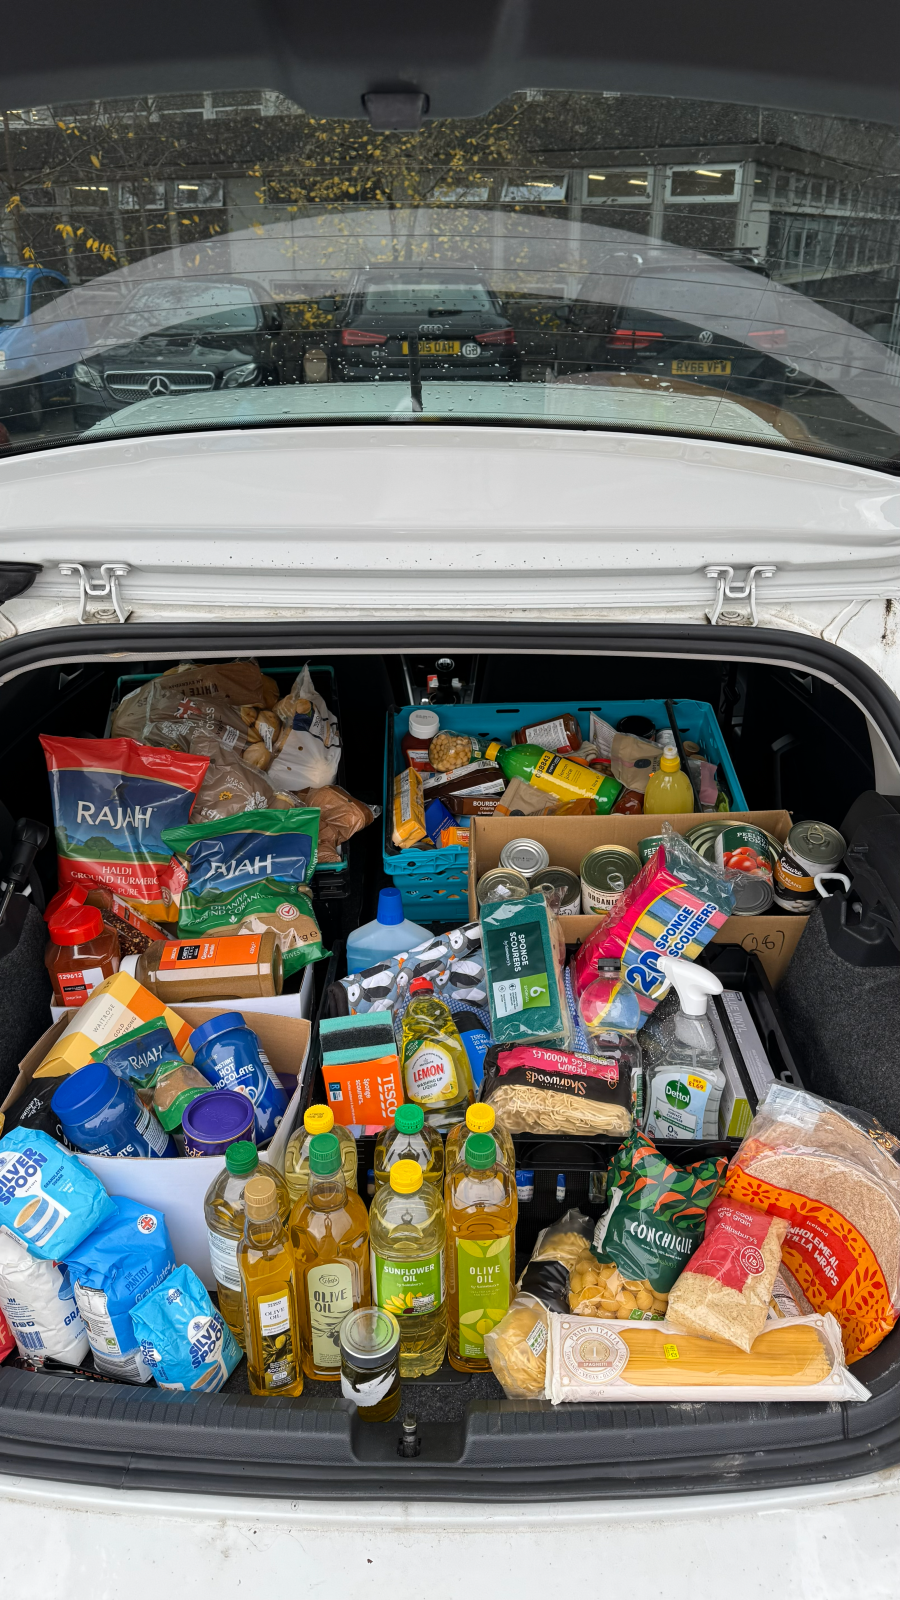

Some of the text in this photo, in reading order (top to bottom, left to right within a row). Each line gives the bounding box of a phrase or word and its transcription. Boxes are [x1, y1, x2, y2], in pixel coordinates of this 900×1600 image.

[465, 345, 479, 356] GB
[676, 362, 727, 373] RY66 VFW
[226, 775, 244, 789] M&S
[77, 800, 152, 829] RAJAH
[71, 871, 159, 885] GROUND TURMERIC
[102, 866, 132, 875] HALDI
[118, 887, 139, 896] PURE
[211, 893, 248, 910] DHANIYA
[655, 906, 694, 950] SPONGE
[668, 903, 717, 957] SCOURERS
[509, 931, 521, 972] SCOURERS
[518, 934, 529, 966] SPONGE
[626, 950, 664, 995] 20
[530, 986, 546, 997] 6
[93, 1003, 115, 1033] WAITROSE
[725, 992, 747, 1033] BLUE VINYL
[114, 1023, 125, 1038] GOLD
[128, 1045, 162, 1070] RAJAH
[533, 1050, 587, 1068] EGG NOODLES
[214, 1064, 255, 1090] HOCOLATE
[219, 1063, 236, 1077] HOT
[413, 1063, 444, 1083] LEMON
[558, 1063, 587, 1075] MEDIUM
[363, 1078, 371, 1099] Sponge
[417, 1078, 436, 1088] WASHING
[526, 1070, 587, 1095] Sharwood's
[688, 1081, 704, 1090] £1.69
[382, 1073, 397, 1118] TESCO
[666, 1085, 690, 1103] Dettol
[0, 1153, 48, 1205] SPOON
[44, 1165, 65, 1188] GRANULATED
[52, 1173, 64, 1186] SUGAR
[733, 1214, 751, 1227] grain
[735, 1210, 753, 1222] cook
[630, 1221, 693, 1254] CONCHIGLIE
[721, 1222, 757, 1244] Sainsbury's
[806, 1220, 828, 1237] Iceland
[788, 1226, 838, 1271] WHOLEMEAL
[749, 1256, 757, 1265] 15
[786, 1233, 839, 1286] TILLA WRAPS
[125, 1271, 133, 1281] THE
[125, 1265, 150, 1292] PANTRY
[383, 1264, 435, 1275] SUNFLOWER
[470, 1265, 500, 1275] OLIVE
[135, 1260, 171, 1304] Granulated
[476, 1275, 494, 1283] OIL
[313, 1288, 348, 1303] OLIVE
[264, 1307, 285, 1317] OLIVE
[314, 1302, 335, 1313] OIL
[189, 1313, 222, 1360] SILVER
[569, 1327, 620, 1346] PRIMA ITALIA
[146, 1341, 158, 1368] SILVER
